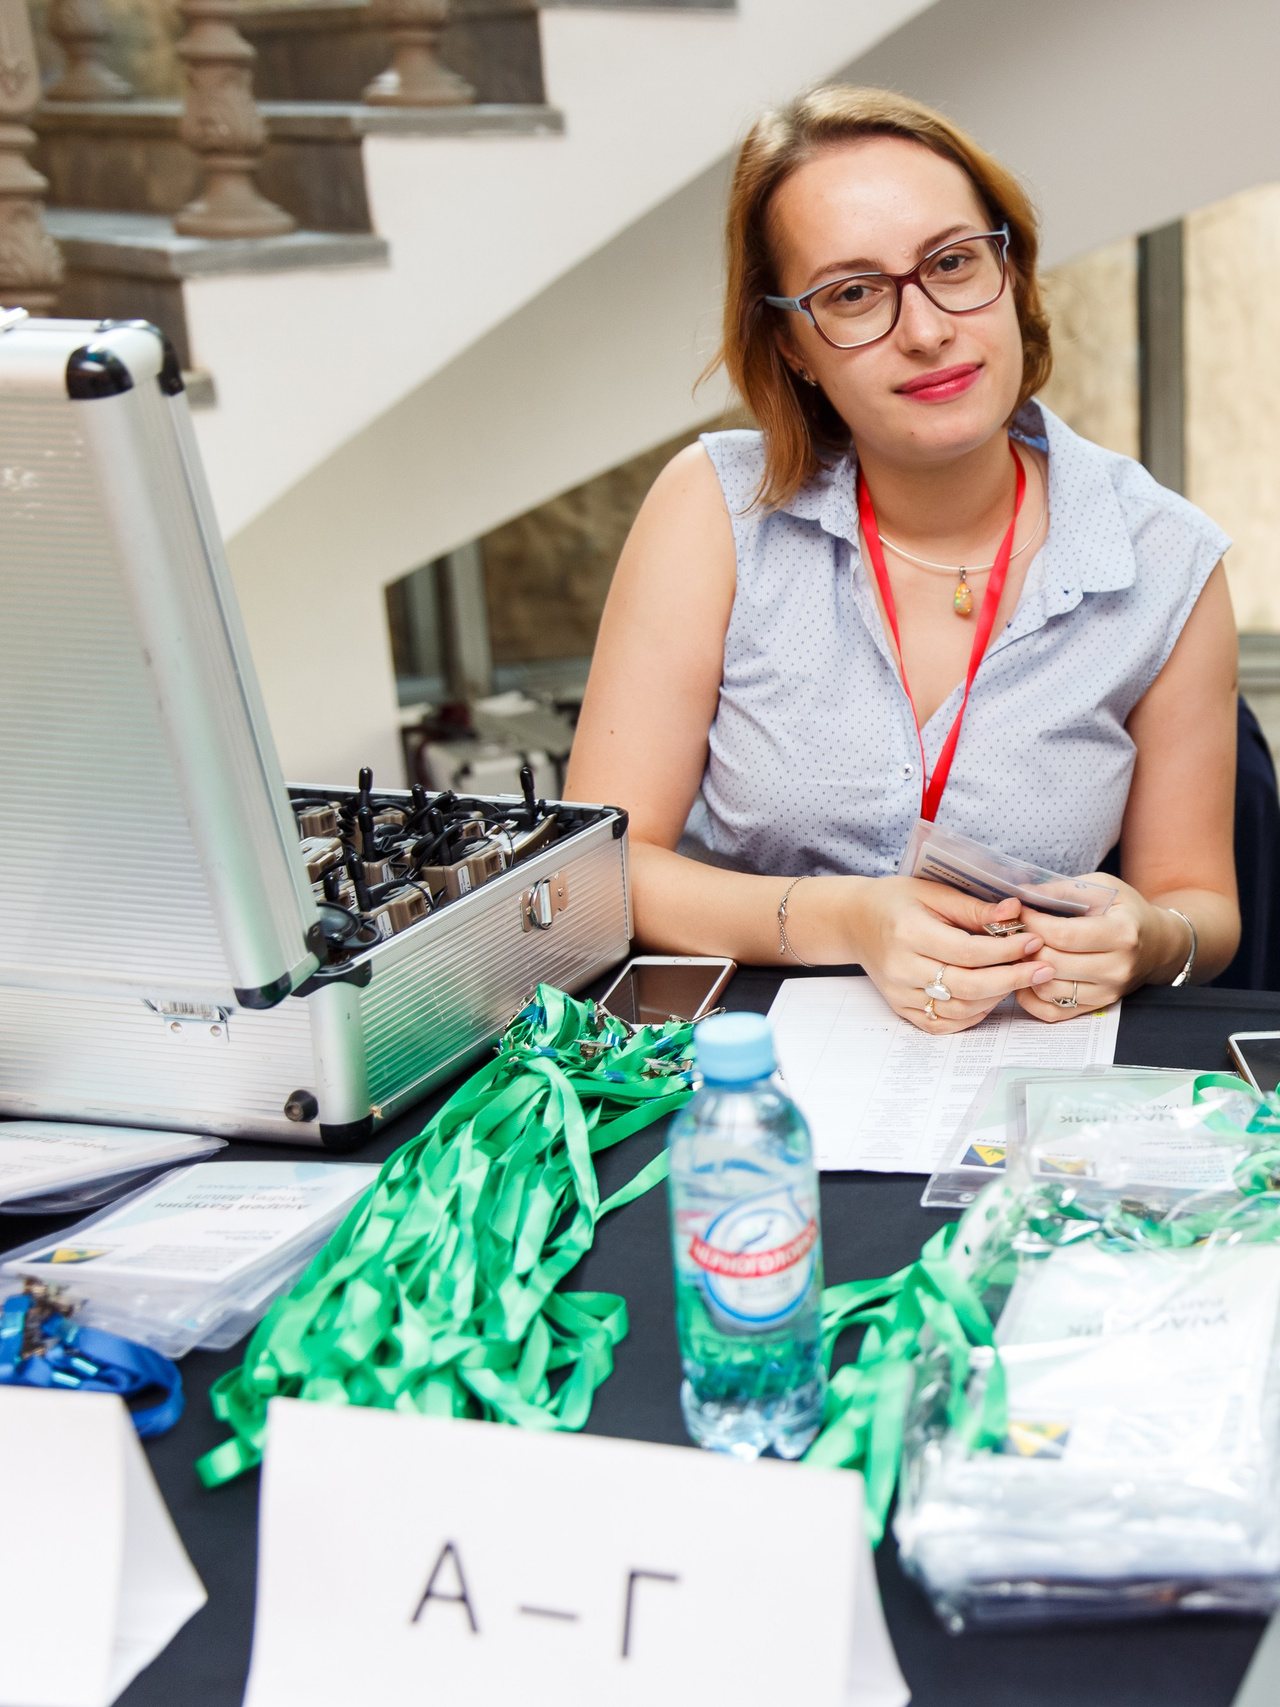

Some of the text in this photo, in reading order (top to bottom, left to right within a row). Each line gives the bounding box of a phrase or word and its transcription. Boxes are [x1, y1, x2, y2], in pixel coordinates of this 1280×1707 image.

[186, 1192, 307, 1202] Andrey Baturin
[154, 1201, 313, 1211] Андрей Батурин
[409, 1540, 479, 1634] А
[620, 1565, 681, 1659] Г
